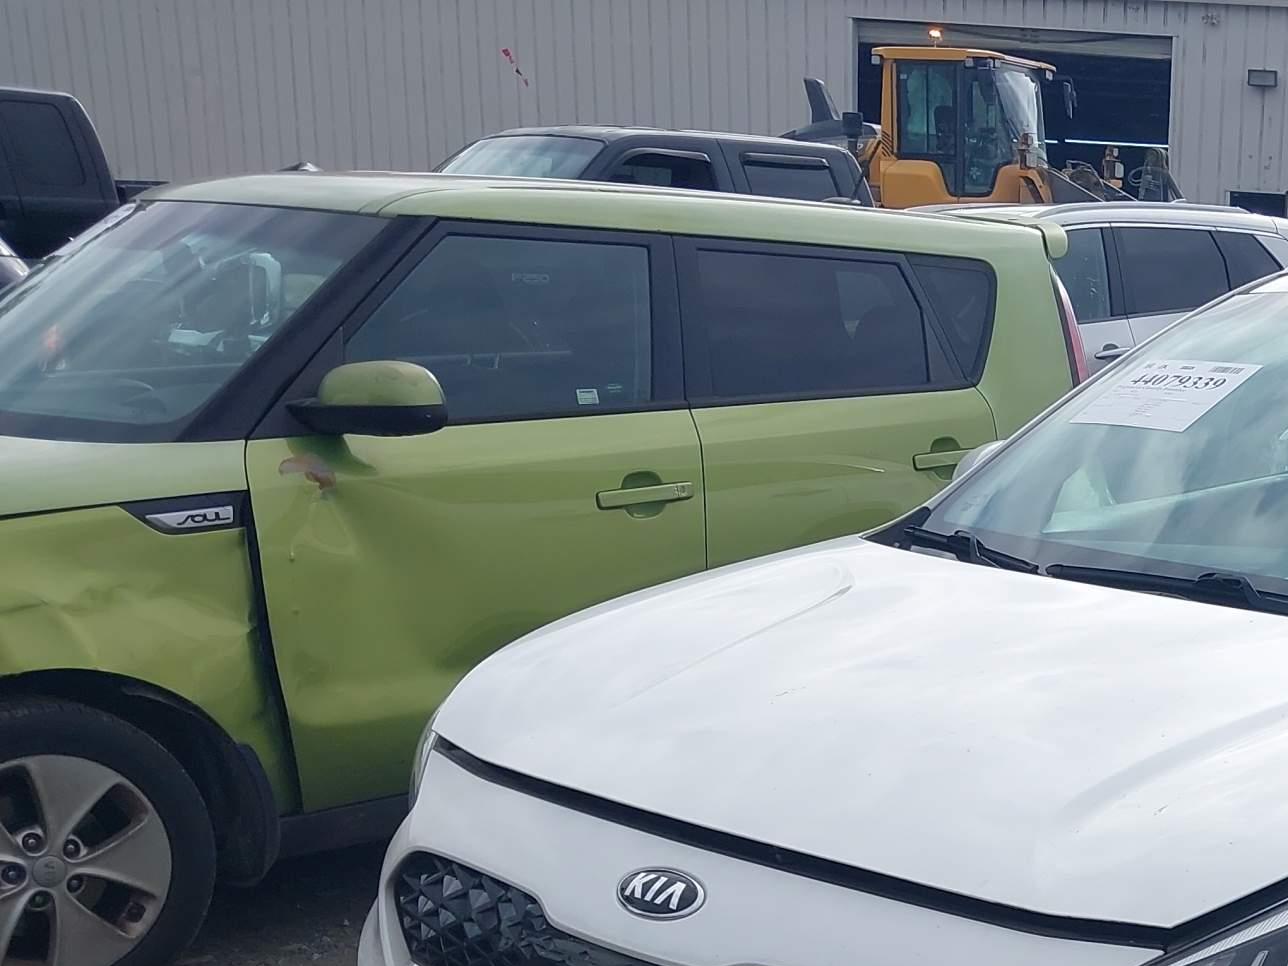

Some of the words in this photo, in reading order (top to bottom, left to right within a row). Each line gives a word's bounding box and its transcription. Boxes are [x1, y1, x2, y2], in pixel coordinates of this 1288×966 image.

[1130, 373, 1227, 390] 44079339
[176, 511, 231, 526] SOUL
[623, 872, 687, 911] KIA
